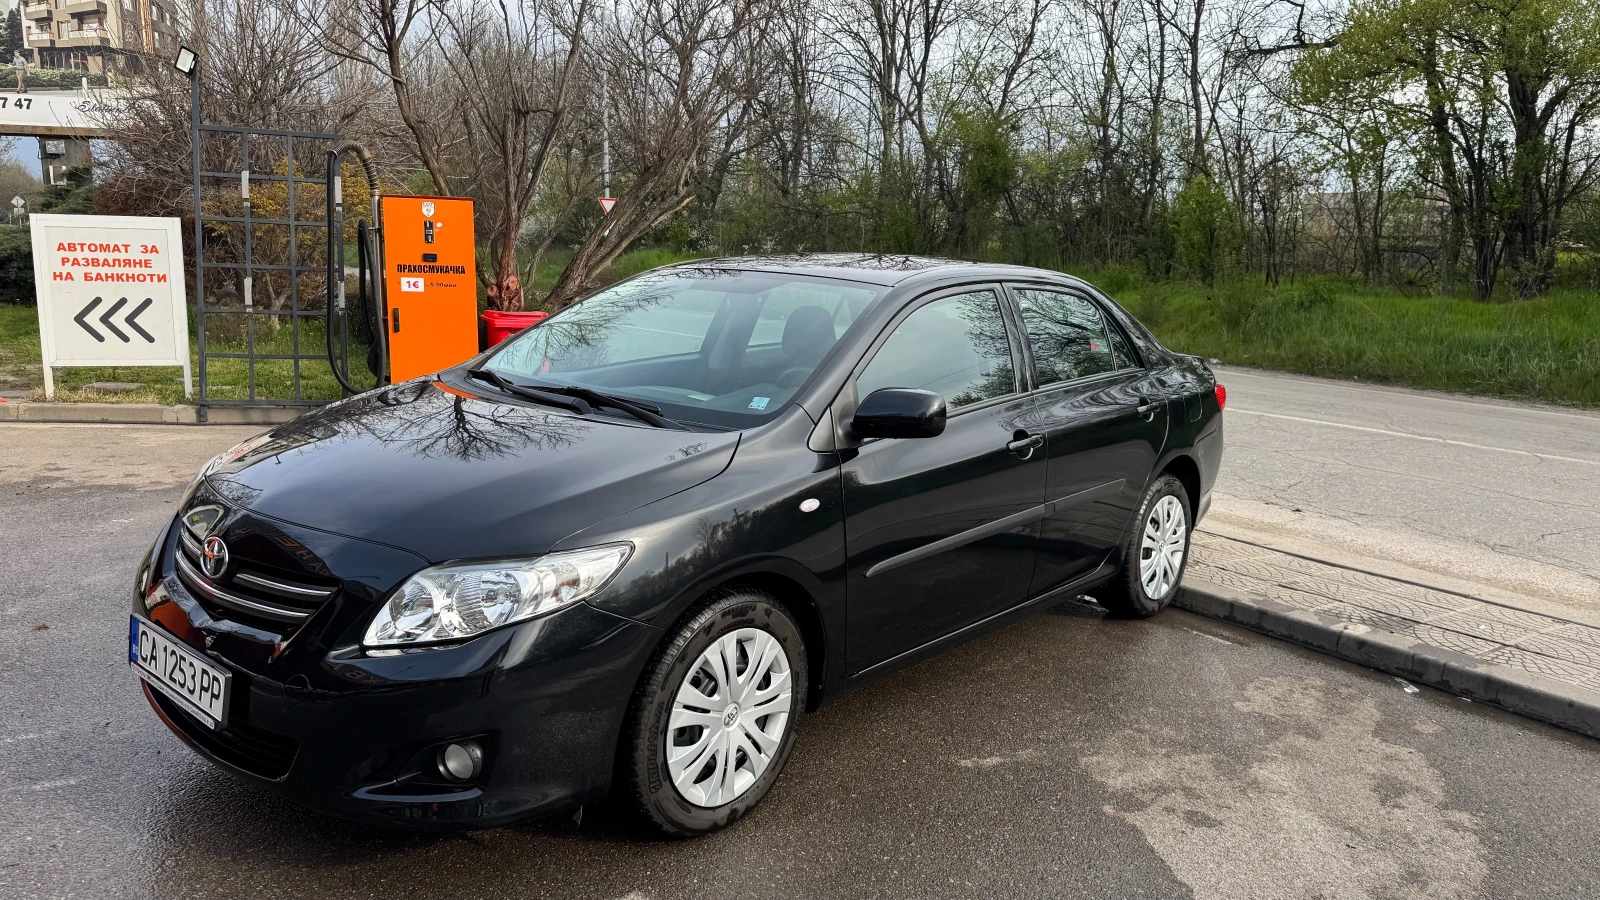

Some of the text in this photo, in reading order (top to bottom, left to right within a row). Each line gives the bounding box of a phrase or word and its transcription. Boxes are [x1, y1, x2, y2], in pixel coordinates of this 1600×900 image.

[14, 98, 33, 110] 47
[56, 242, 160, 254] АВТОМАТ ЗА
[61, 257, 153, 269] РАЗВАЛЯНЕ
[397, 264, 466, 275] ПРАХОСМУКАЧКА
[52, 271, 167, 283] НА БАНКНОТИ
[405, 280, 420, 289] 1€
[140, 629, 158, 671] CA
[163, 644, 197, 696] 1253
[199, 667, 222, 710] PP
